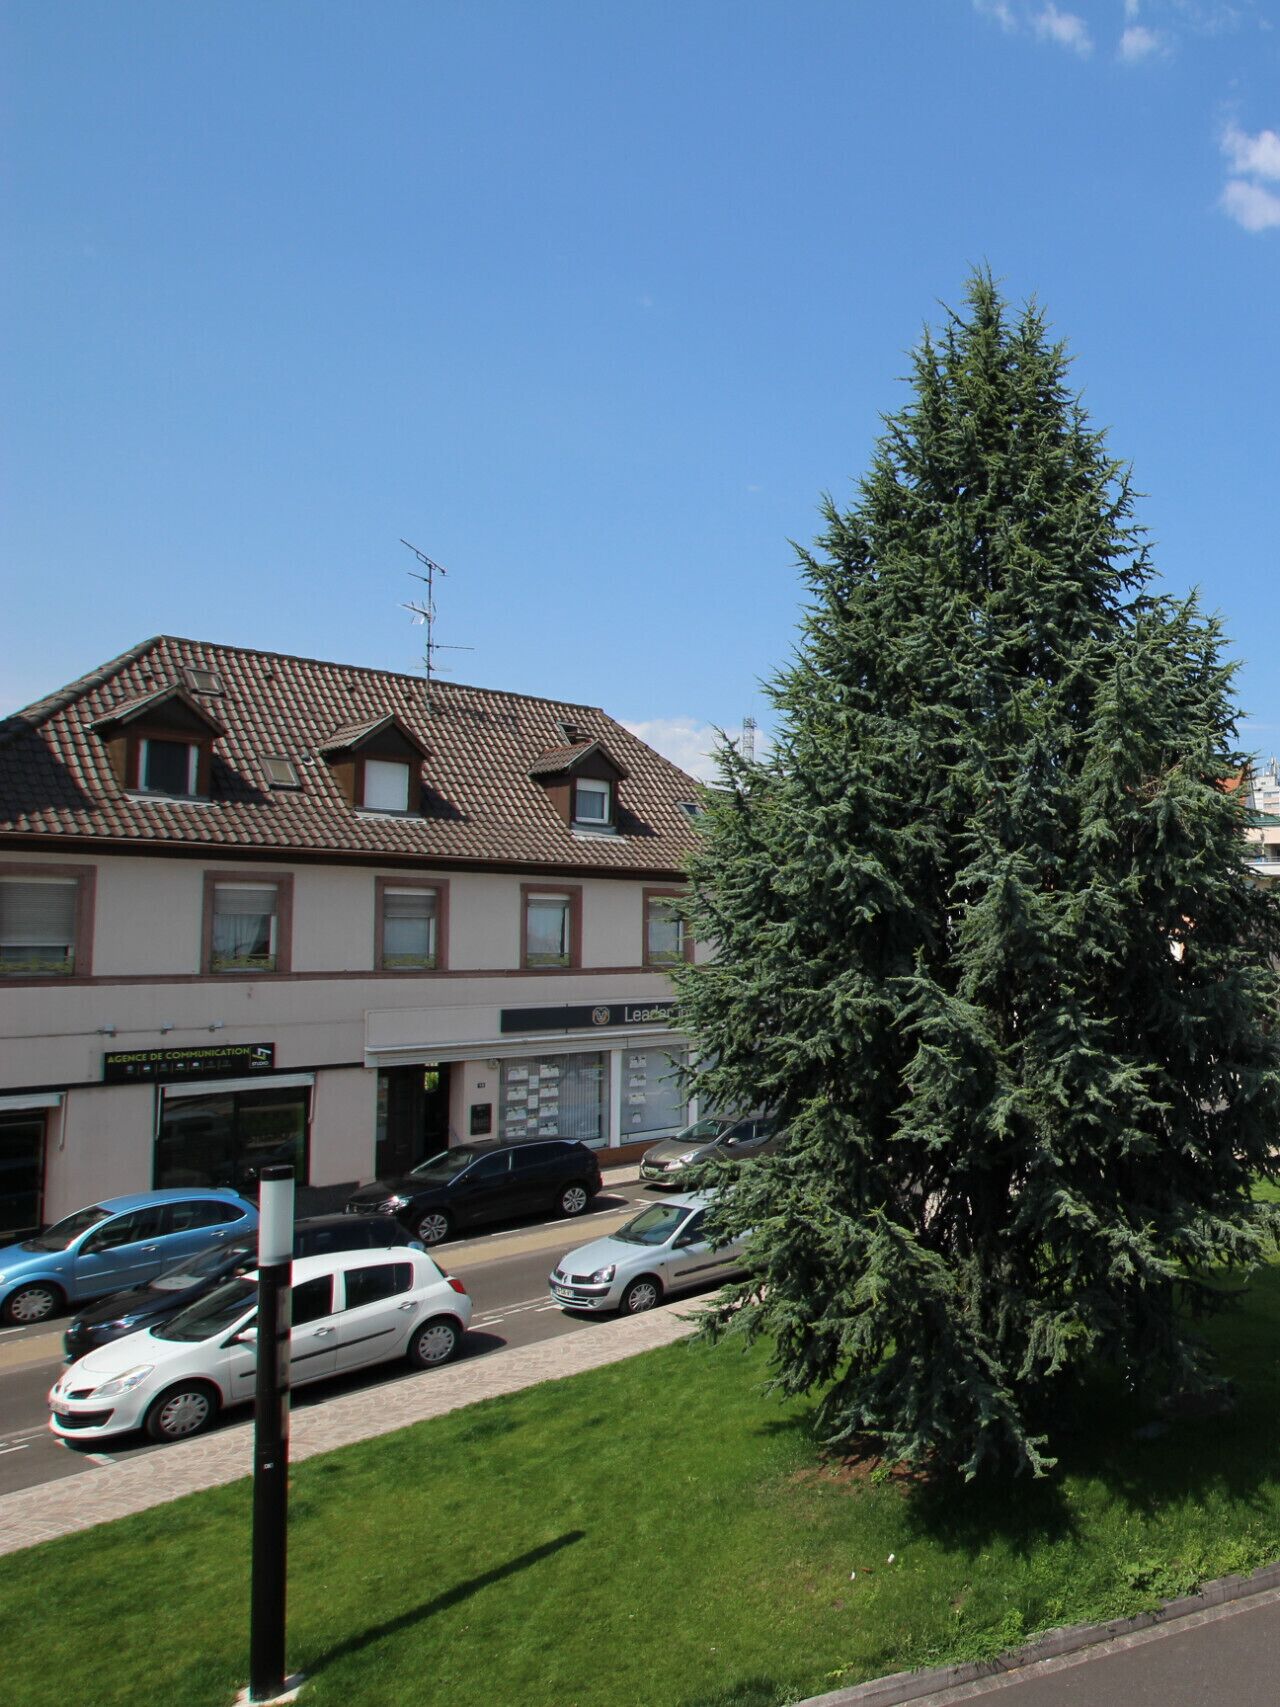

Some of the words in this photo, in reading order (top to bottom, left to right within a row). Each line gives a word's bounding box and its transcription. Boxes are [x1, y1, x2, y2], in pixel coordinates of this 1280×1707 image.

[624, 1005, 674, 1022] Leader
[107, 1053, 147, 1063] AGENCE
[150, 1052, 163, 1061] DE
[166, 1047, 250, 1060] COMMUNICATION
